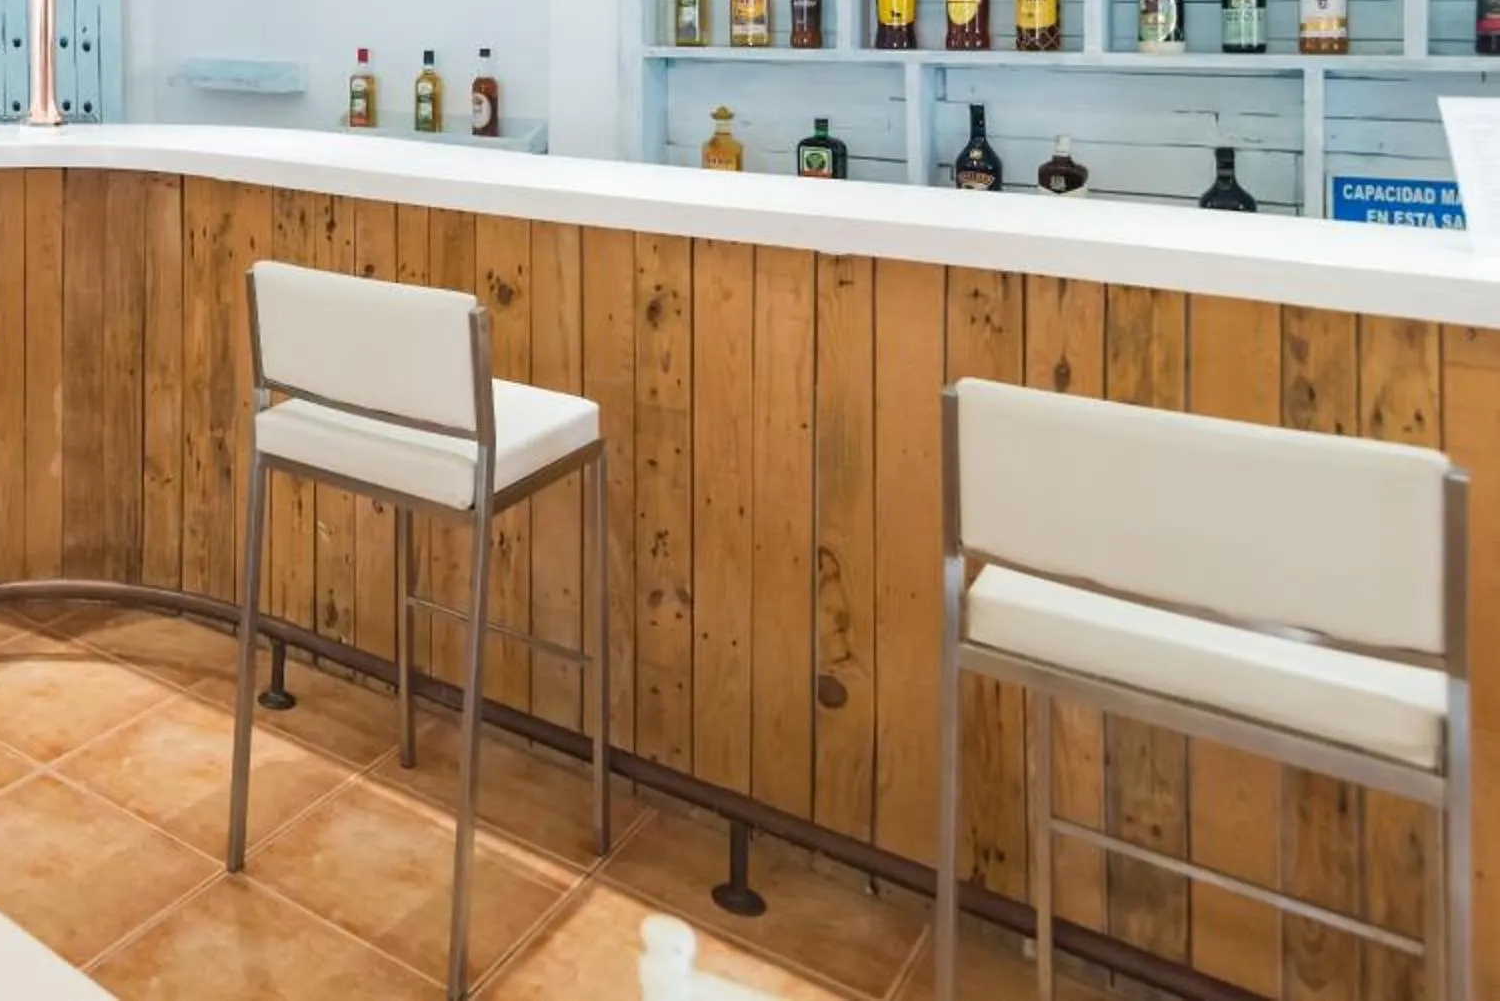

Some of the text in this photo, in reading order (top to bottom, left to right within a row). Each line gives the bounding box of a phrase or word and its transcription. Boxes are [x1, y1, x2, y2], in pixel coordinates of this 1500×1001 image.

[1342, 183, 1436, 204] CAPACIDAD
[1366, 208, 1389, 224] EN
[1393, 211, 1437, 228] ESTA
